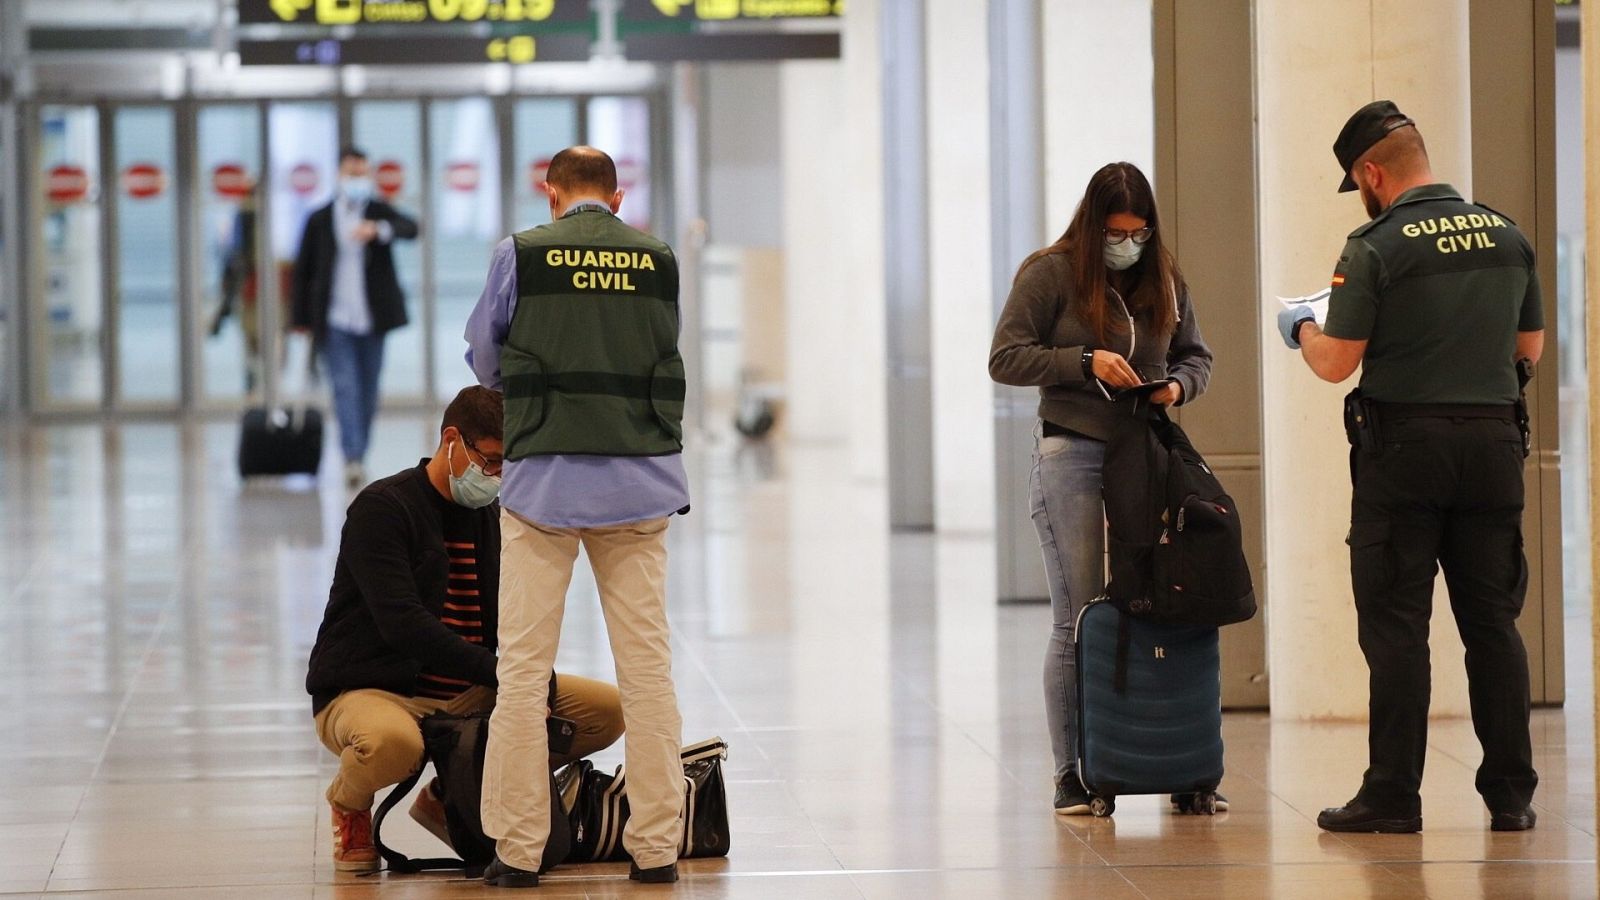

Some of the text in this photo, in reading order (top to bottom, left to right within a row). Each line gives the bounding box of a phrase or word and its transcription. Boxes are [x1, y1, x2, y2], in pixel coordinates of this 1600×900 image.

[1402, 213, 1507, 238] GUARDIA
[1436, 232, 1496, 254] CIVIL
[546, 249, 656, 271] GUARDIA
[572, 271, 636, 291] CIVIL
[1154, 646, 1165, 659] it
